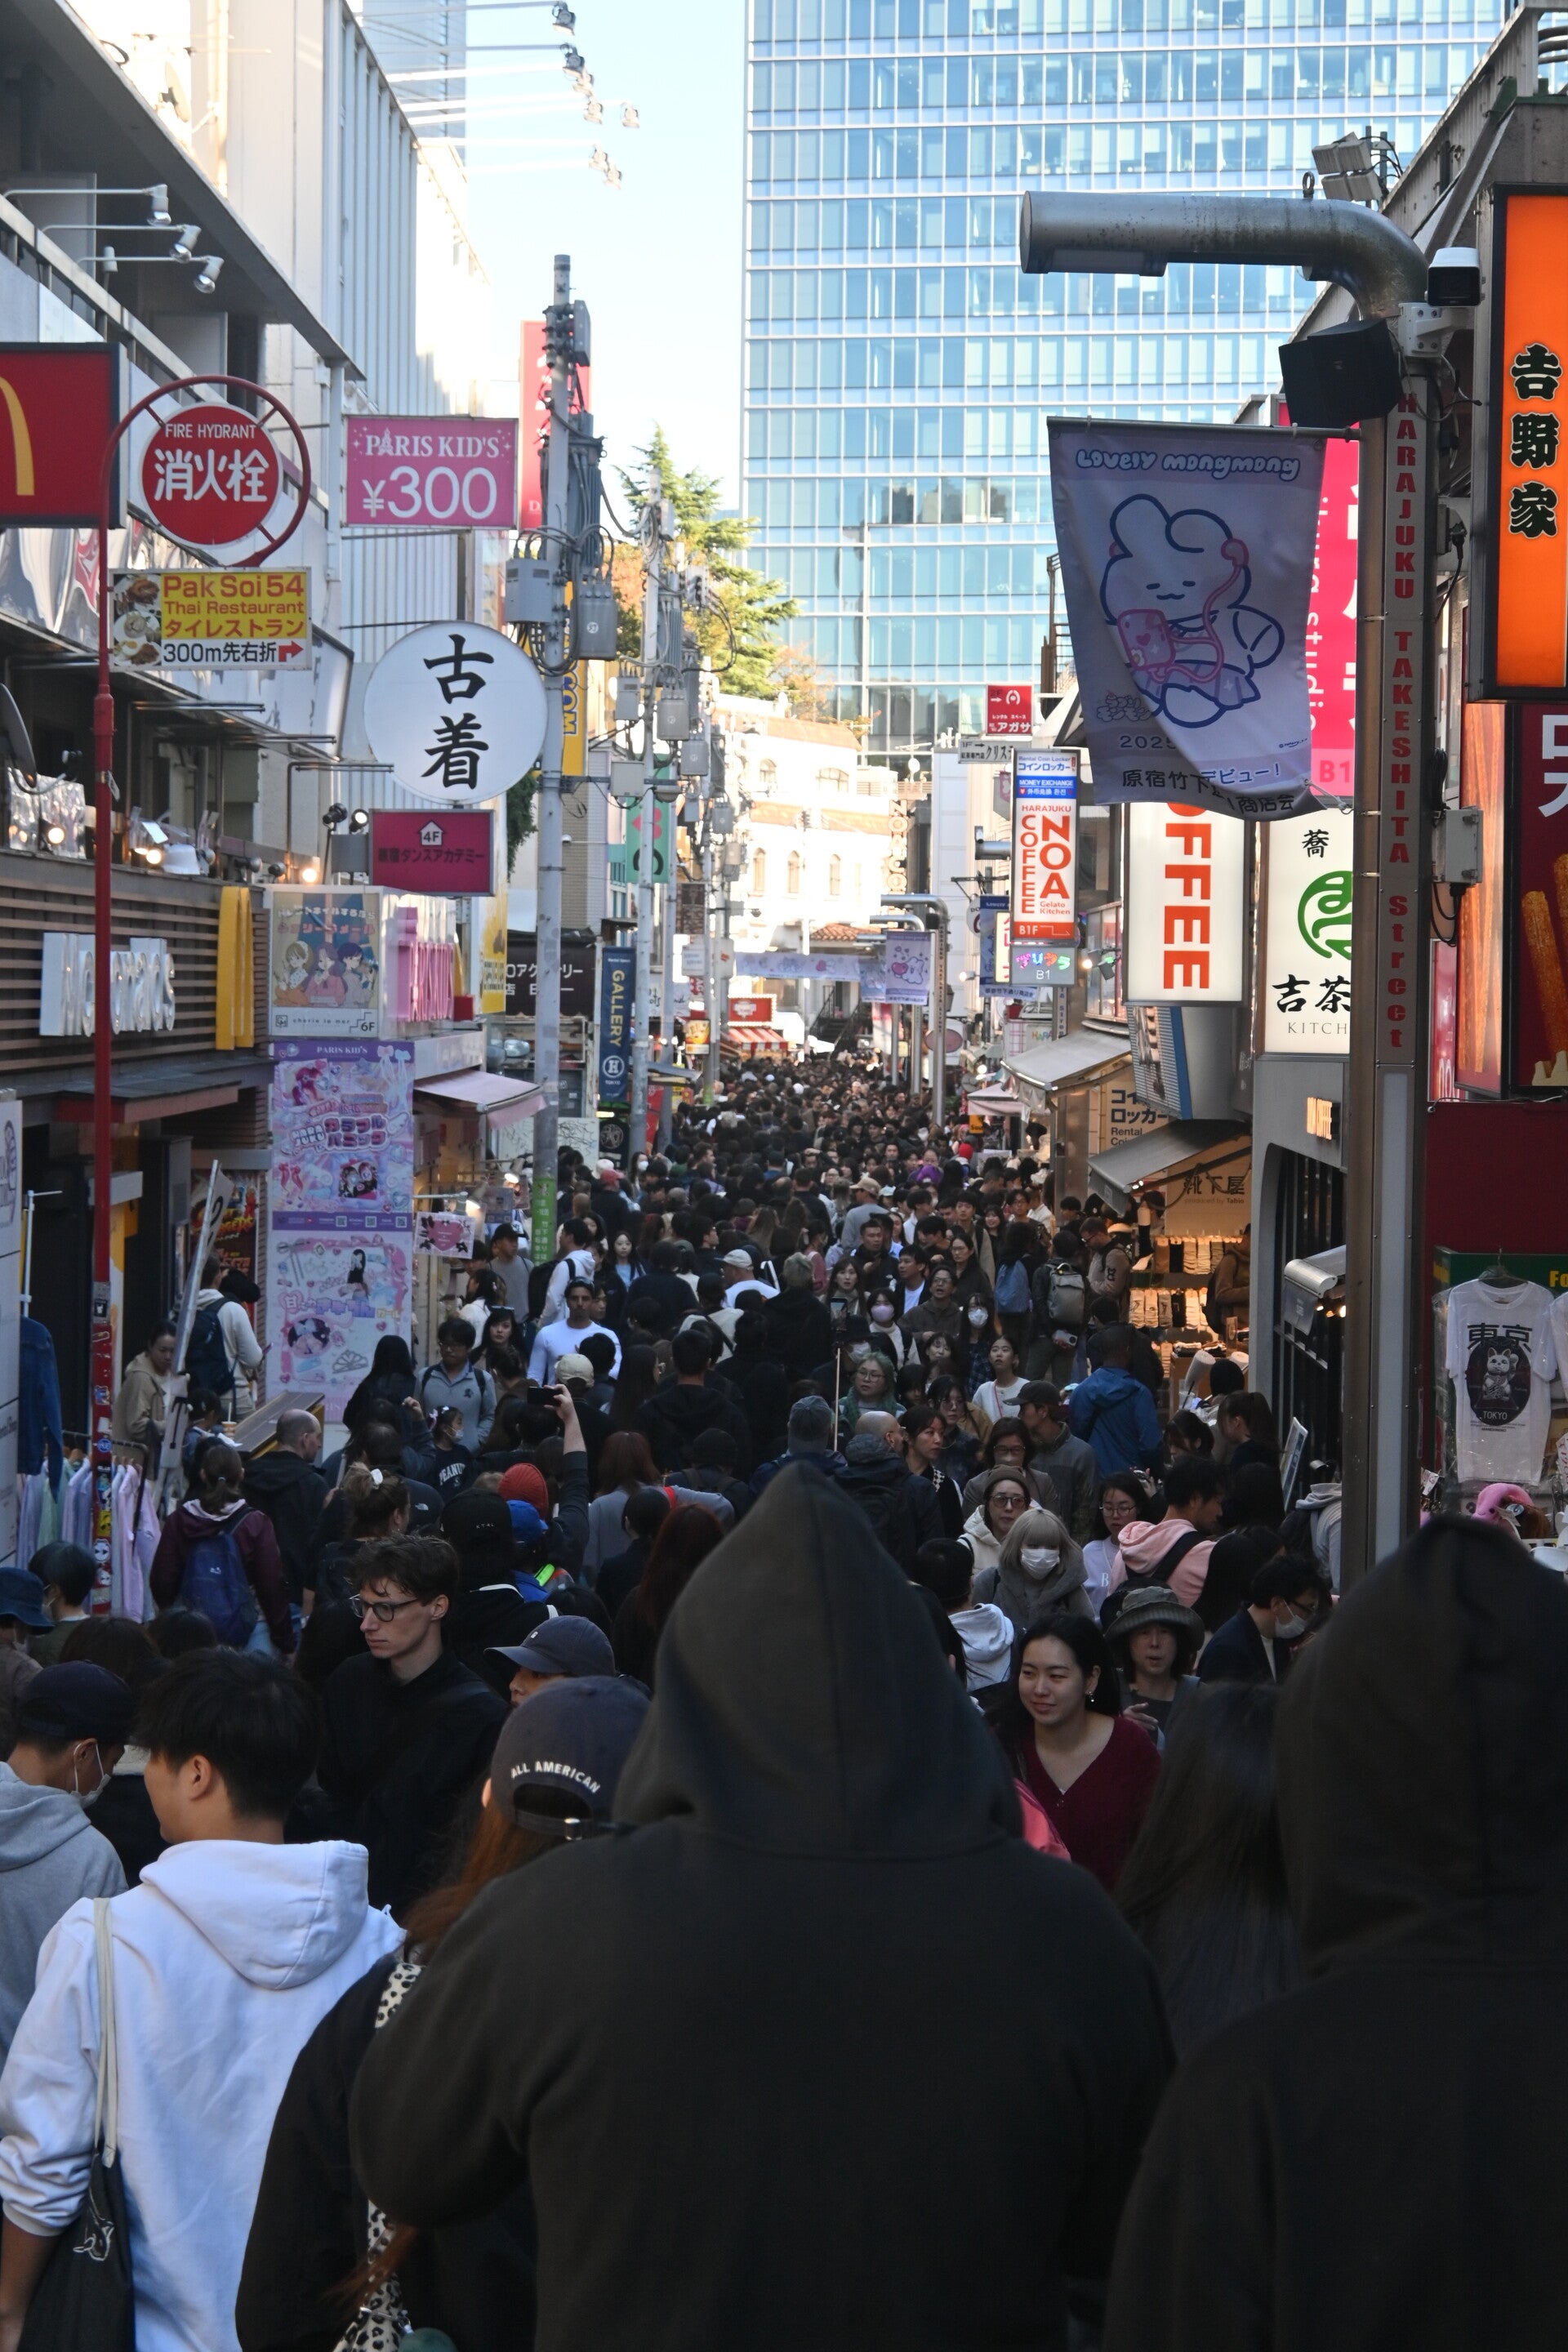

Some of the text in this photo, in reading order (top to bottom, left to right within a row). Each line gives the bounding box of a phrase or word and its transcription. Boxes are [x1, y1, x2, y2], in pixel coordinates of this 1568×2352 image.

[166, 424, 256, 439] FIRE HYDRANT
[365, 427, 500, 458] PARIS KID'S
[154, 448, 270, 502] 消火栓
[362, 466, 497, 519] ¥300
[1394, 393, 1418, 599] HARAJUKU
[163, 574, 304, 598] Pak Soi 54
[167, 601, 305, 614] Thai Restaurant
[166, 618, 305, 638] タイレストラン
[163, 642, 277, 663] 300m先右折
[421, 634, 494, 790] 古着
[997, 722, 1031, 733] アガサ
[1389, 631, 1414, 863] TAKESHITA
[1018, 763, 1071, 771] コインロッカー
[1319, 760, 1350, 783] B1
[423, 831, 440, 843] 4F
[1020, 815, 1038, 914] COFFEE
[1040, 815, 1071, 899] NOA
[1018, 924, 1038, 935] B1F
[1036, 970, 1051, 980] B1
[609, 970, 626, 1048] GALLERY
[360, 1022, 375, 1031] 6F
[1288, 1022, 1347, 1034] KITCH
[345, 1045, 368, 1054] KID'S
[1111, 1108, 1169, 1125] ロッカー
[1111, 1127, 1143, 1136] Rental
[1468, 1322, 1533, 1353] 東京
[1482, 1410, 1508, 1420] TOKYO
[510, 1760, 601, 1794] ALL AMERICAN
